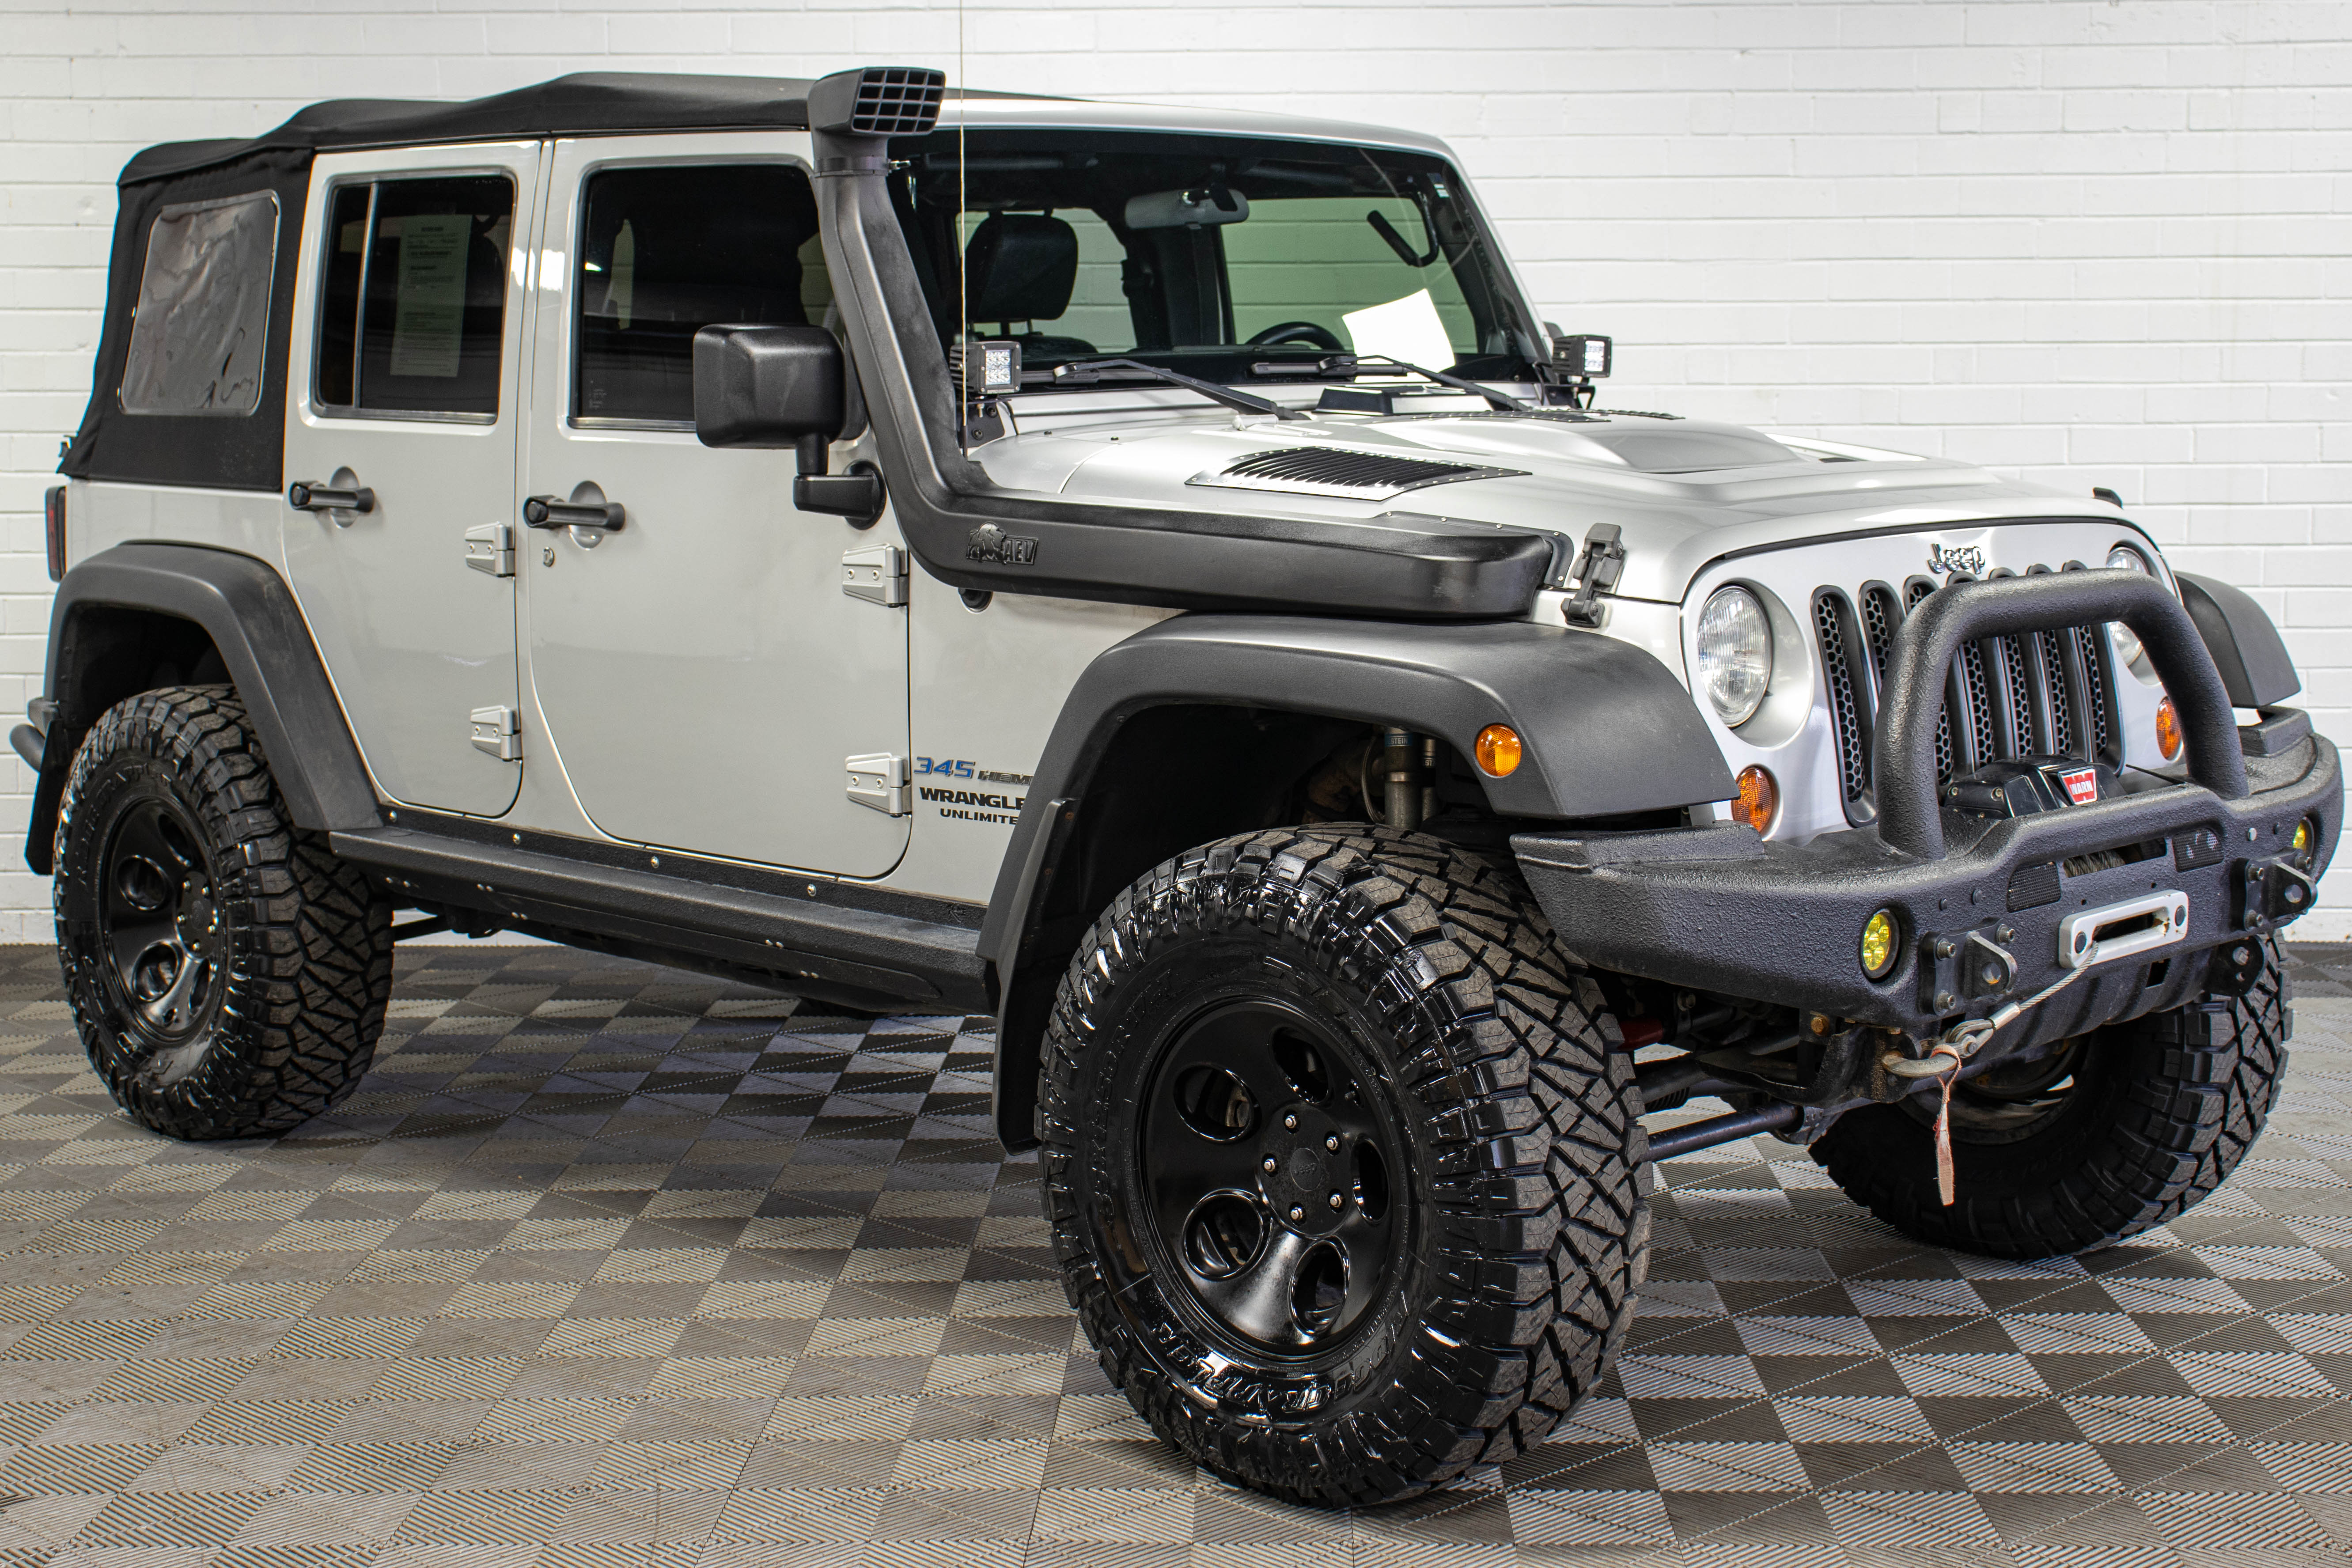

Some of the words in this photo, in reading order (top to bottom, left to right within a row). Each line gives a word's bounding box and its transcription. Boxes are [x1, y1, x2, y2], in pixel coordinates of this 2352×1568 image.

[1004, 539, 1035, 563] AEV
[1927, 543, 1985, 574] Jeep
[914, 756, 976, 779] 345
[977, 770, 1034, 785] HEM
[2069, 780, 2093, 795] WARN
